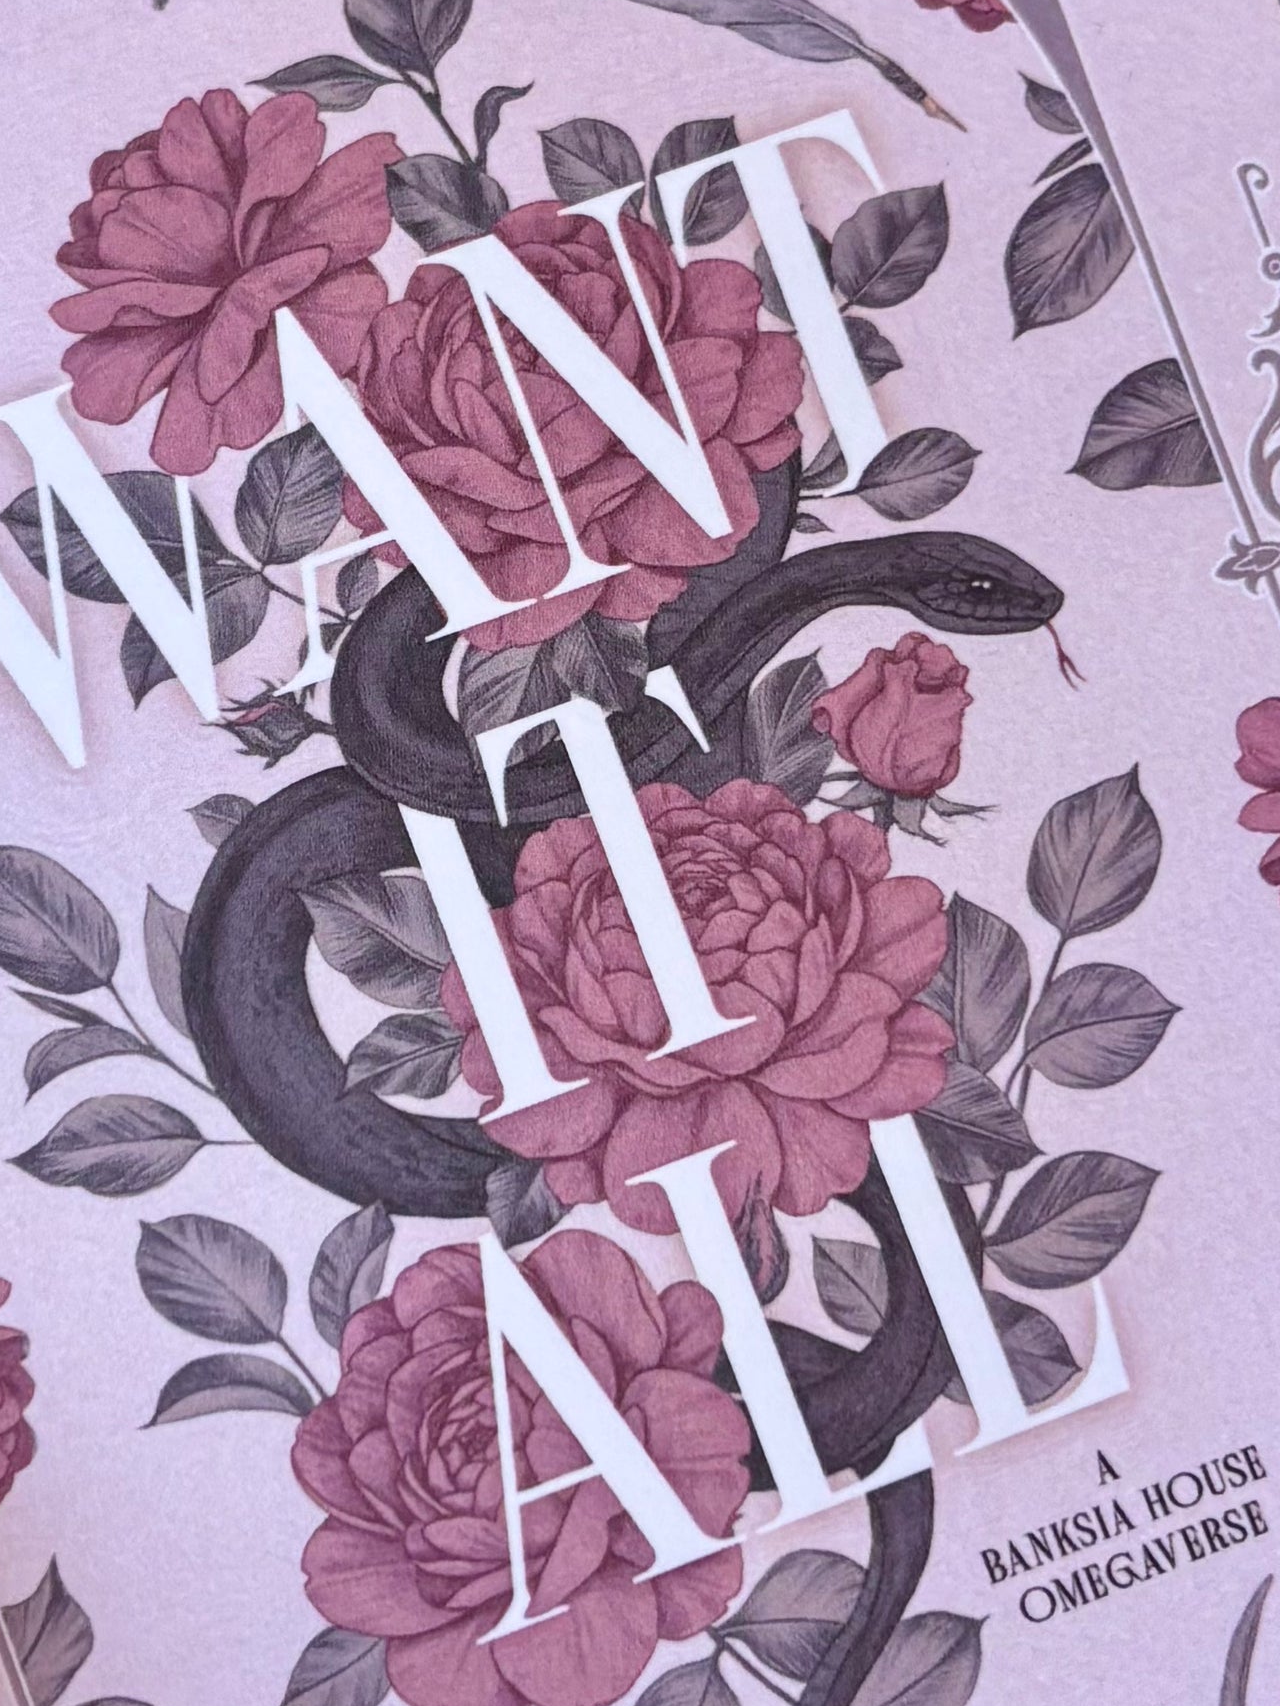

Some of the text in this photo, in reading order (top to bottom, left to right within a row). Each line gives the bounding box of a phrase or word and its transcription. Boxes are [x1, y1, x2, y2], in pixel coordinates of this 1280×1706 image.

[381, 664, 757, 1124] IT
[476, 1113, 1131, 1645] ALL
[979, 1444, 1268, 1584] BANKSIA HOUSE
[1097, 1449, 1121, 1486] A
[1019, 1499, 1269, 1623] OMEGAVERSE
